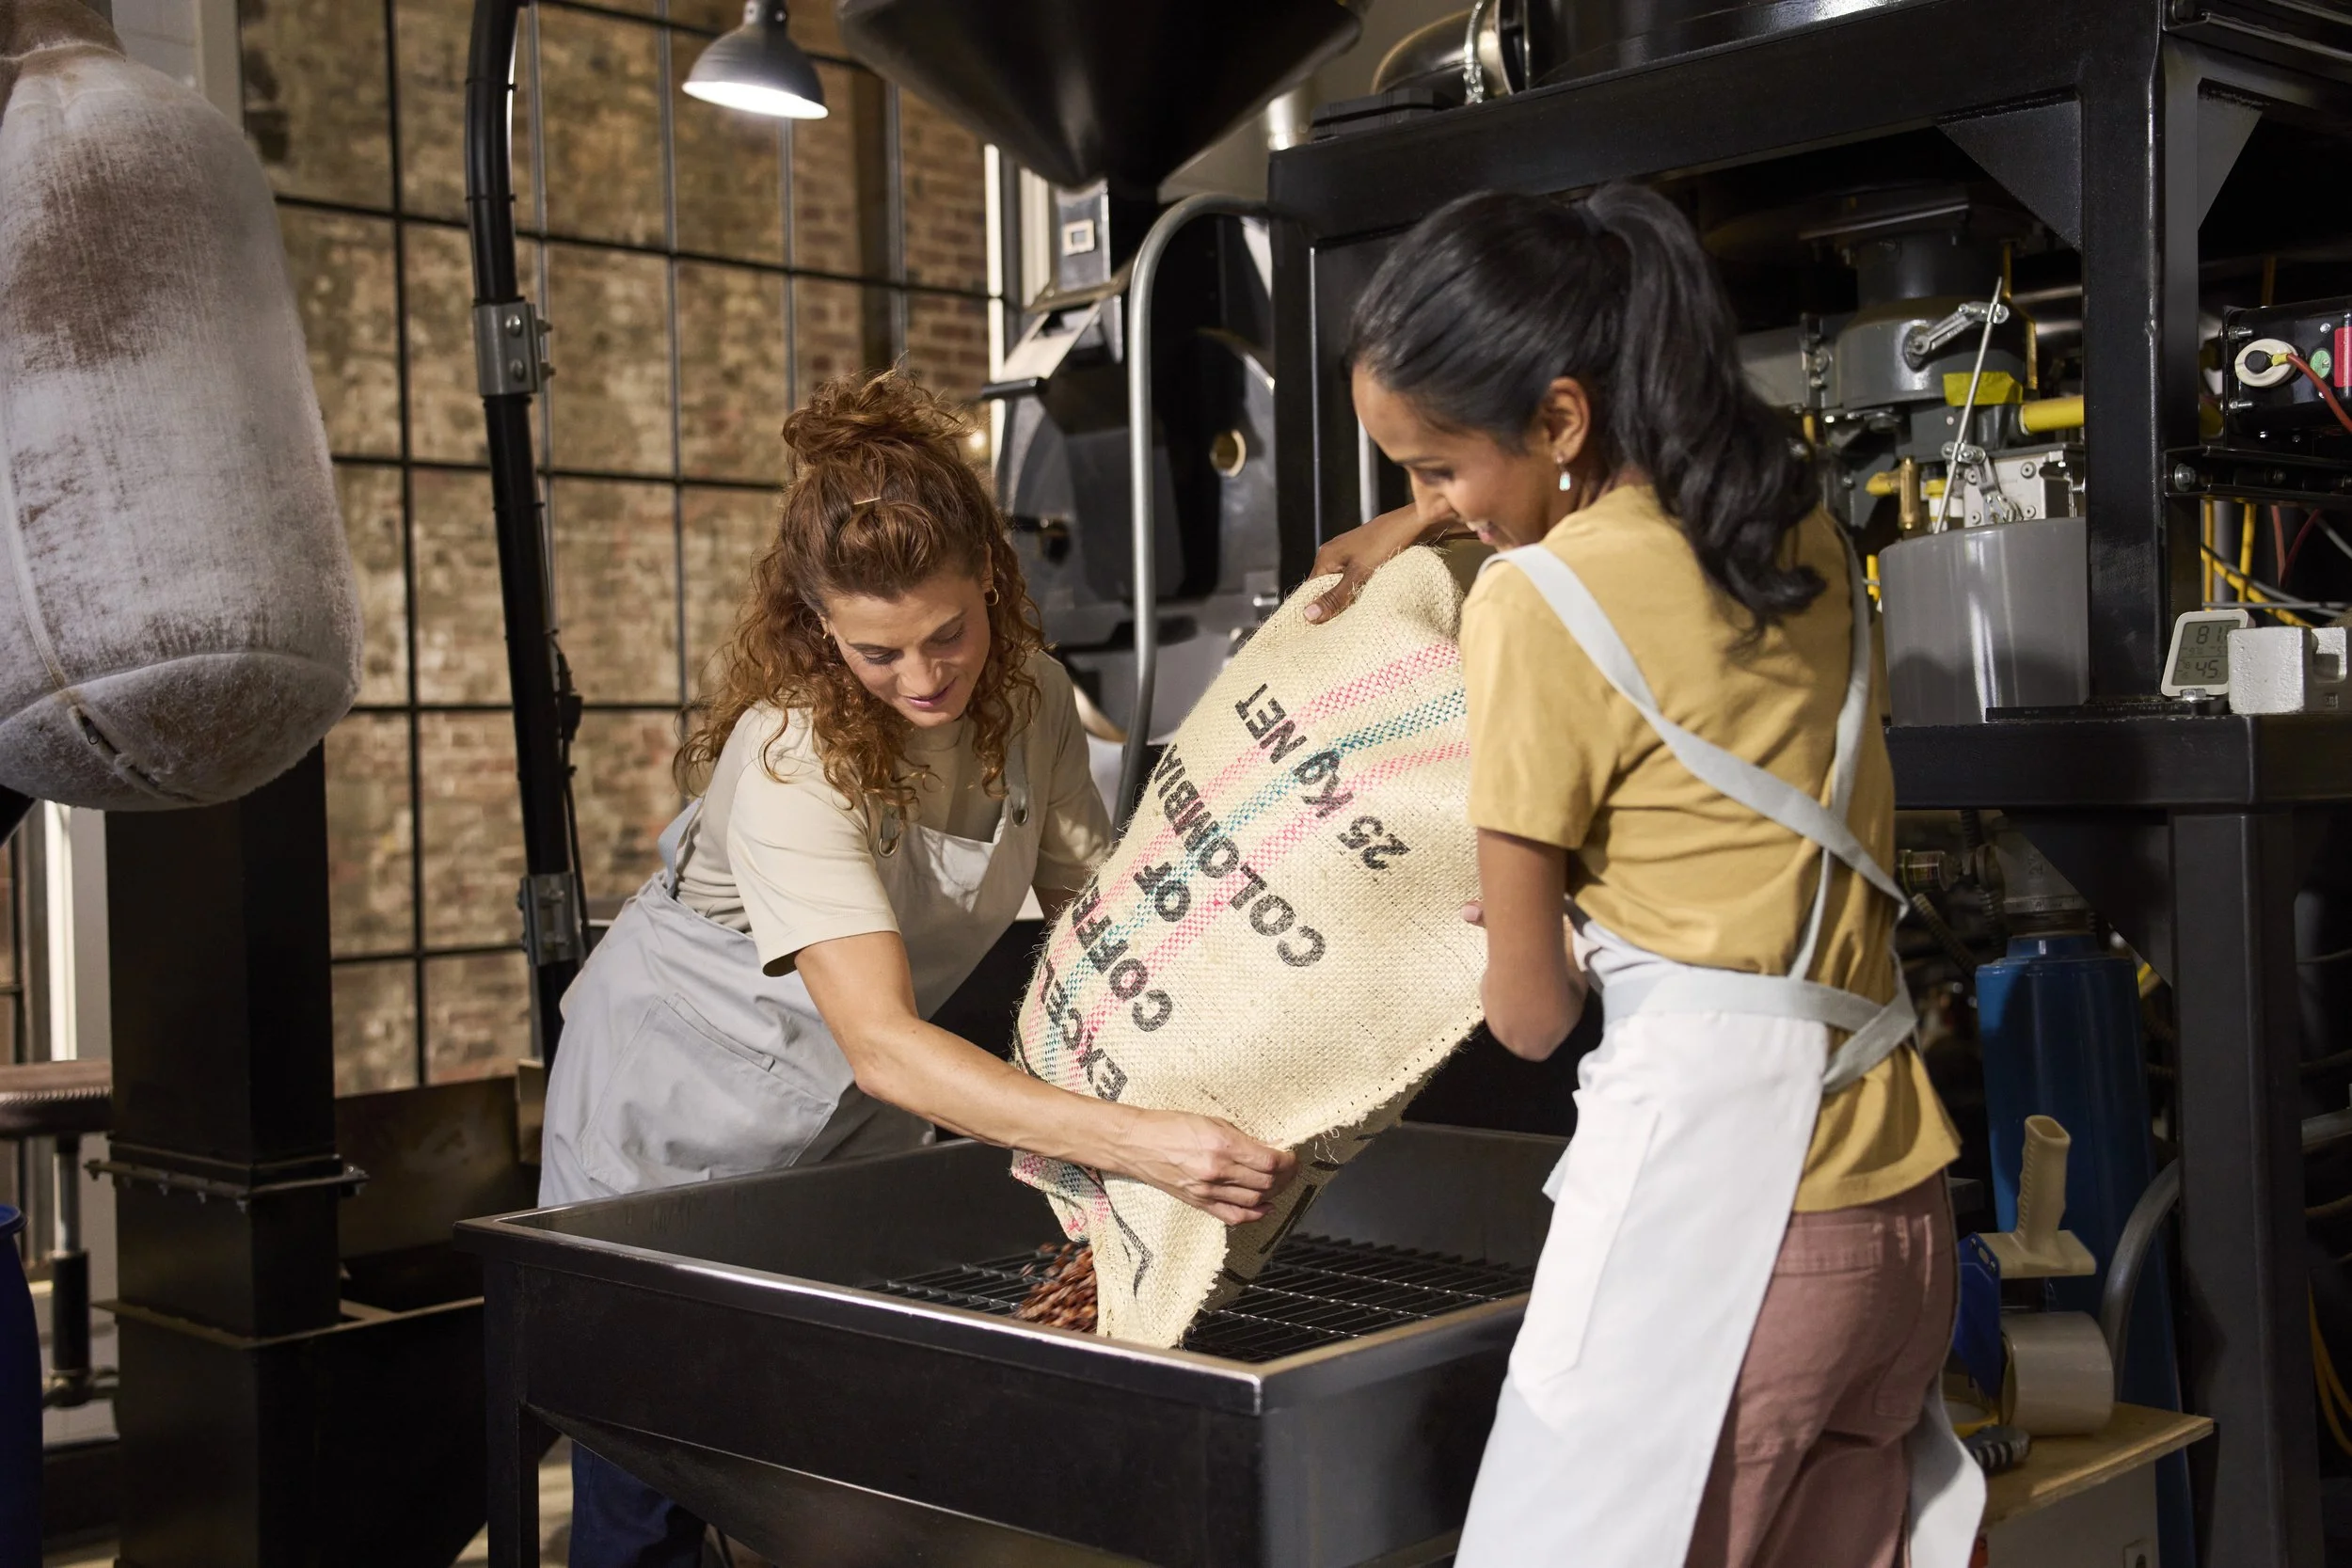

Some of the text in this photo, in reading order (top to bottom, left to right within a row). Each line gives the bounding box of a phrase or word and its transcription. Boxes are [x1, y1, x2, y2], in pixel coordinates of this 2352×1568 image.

[2195, 659, 2218, 678] 45
[1235, 683, 1308, 764] NET
[1154, 745, 1326, 967] COLOMBIA
[1337, 816, 1410, 870] 25
[1133, 862, 1191, 922] OF
[1039, 944, 1128, 1102] EXCEL
